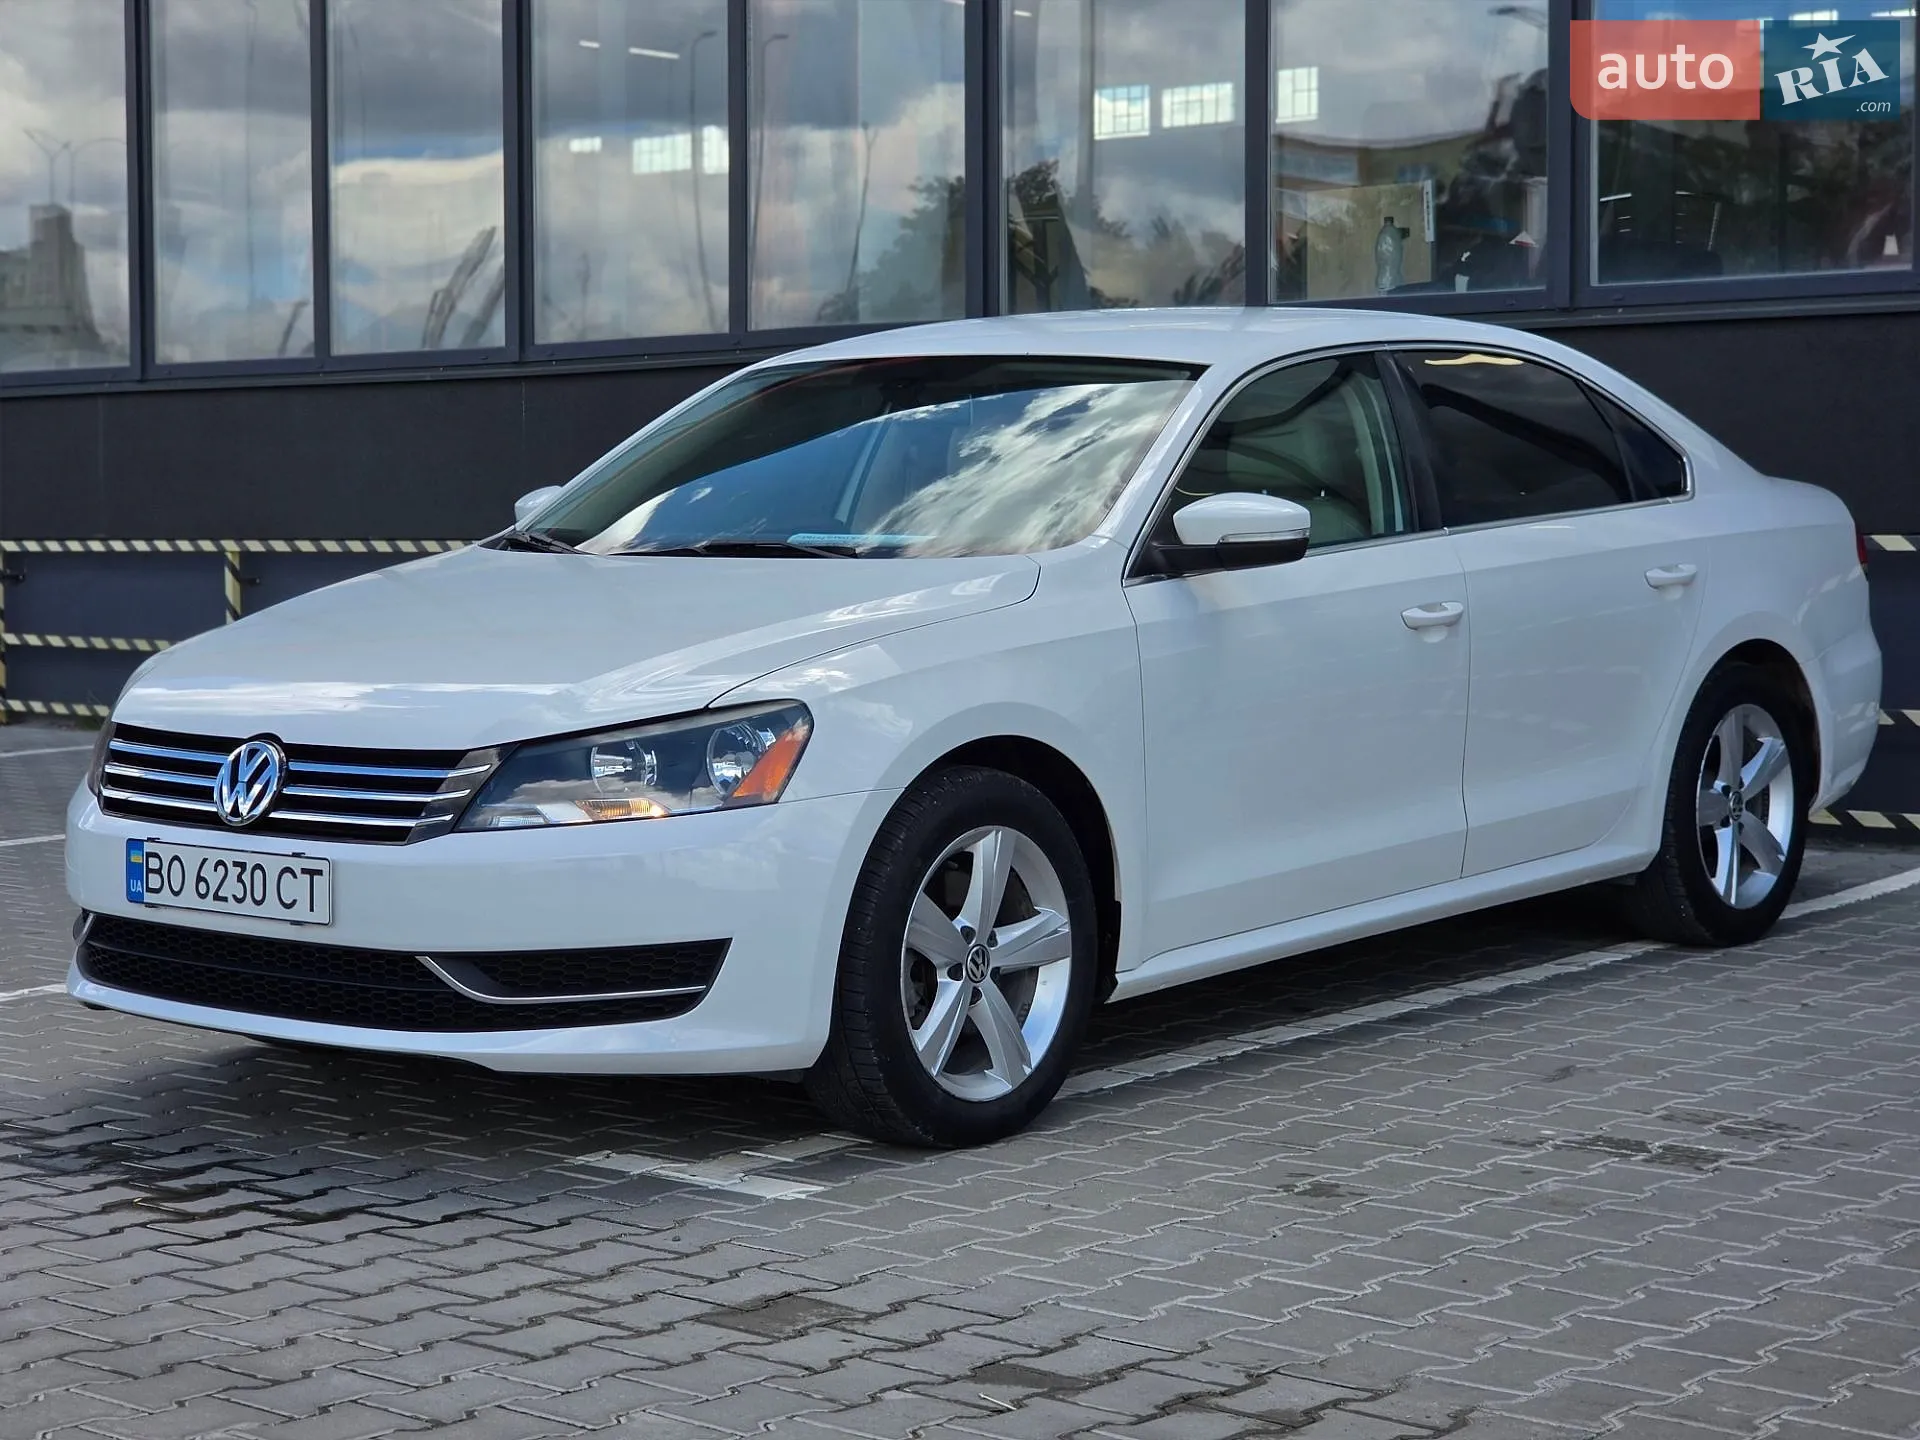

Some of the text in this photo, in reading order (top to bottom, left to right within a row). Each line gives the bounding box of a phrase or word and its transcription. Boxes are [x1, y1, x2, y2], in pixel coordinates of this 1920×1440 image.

[130, 879, 143, 893] UA
[145, 851, 324, 913] BO 6230 CT
